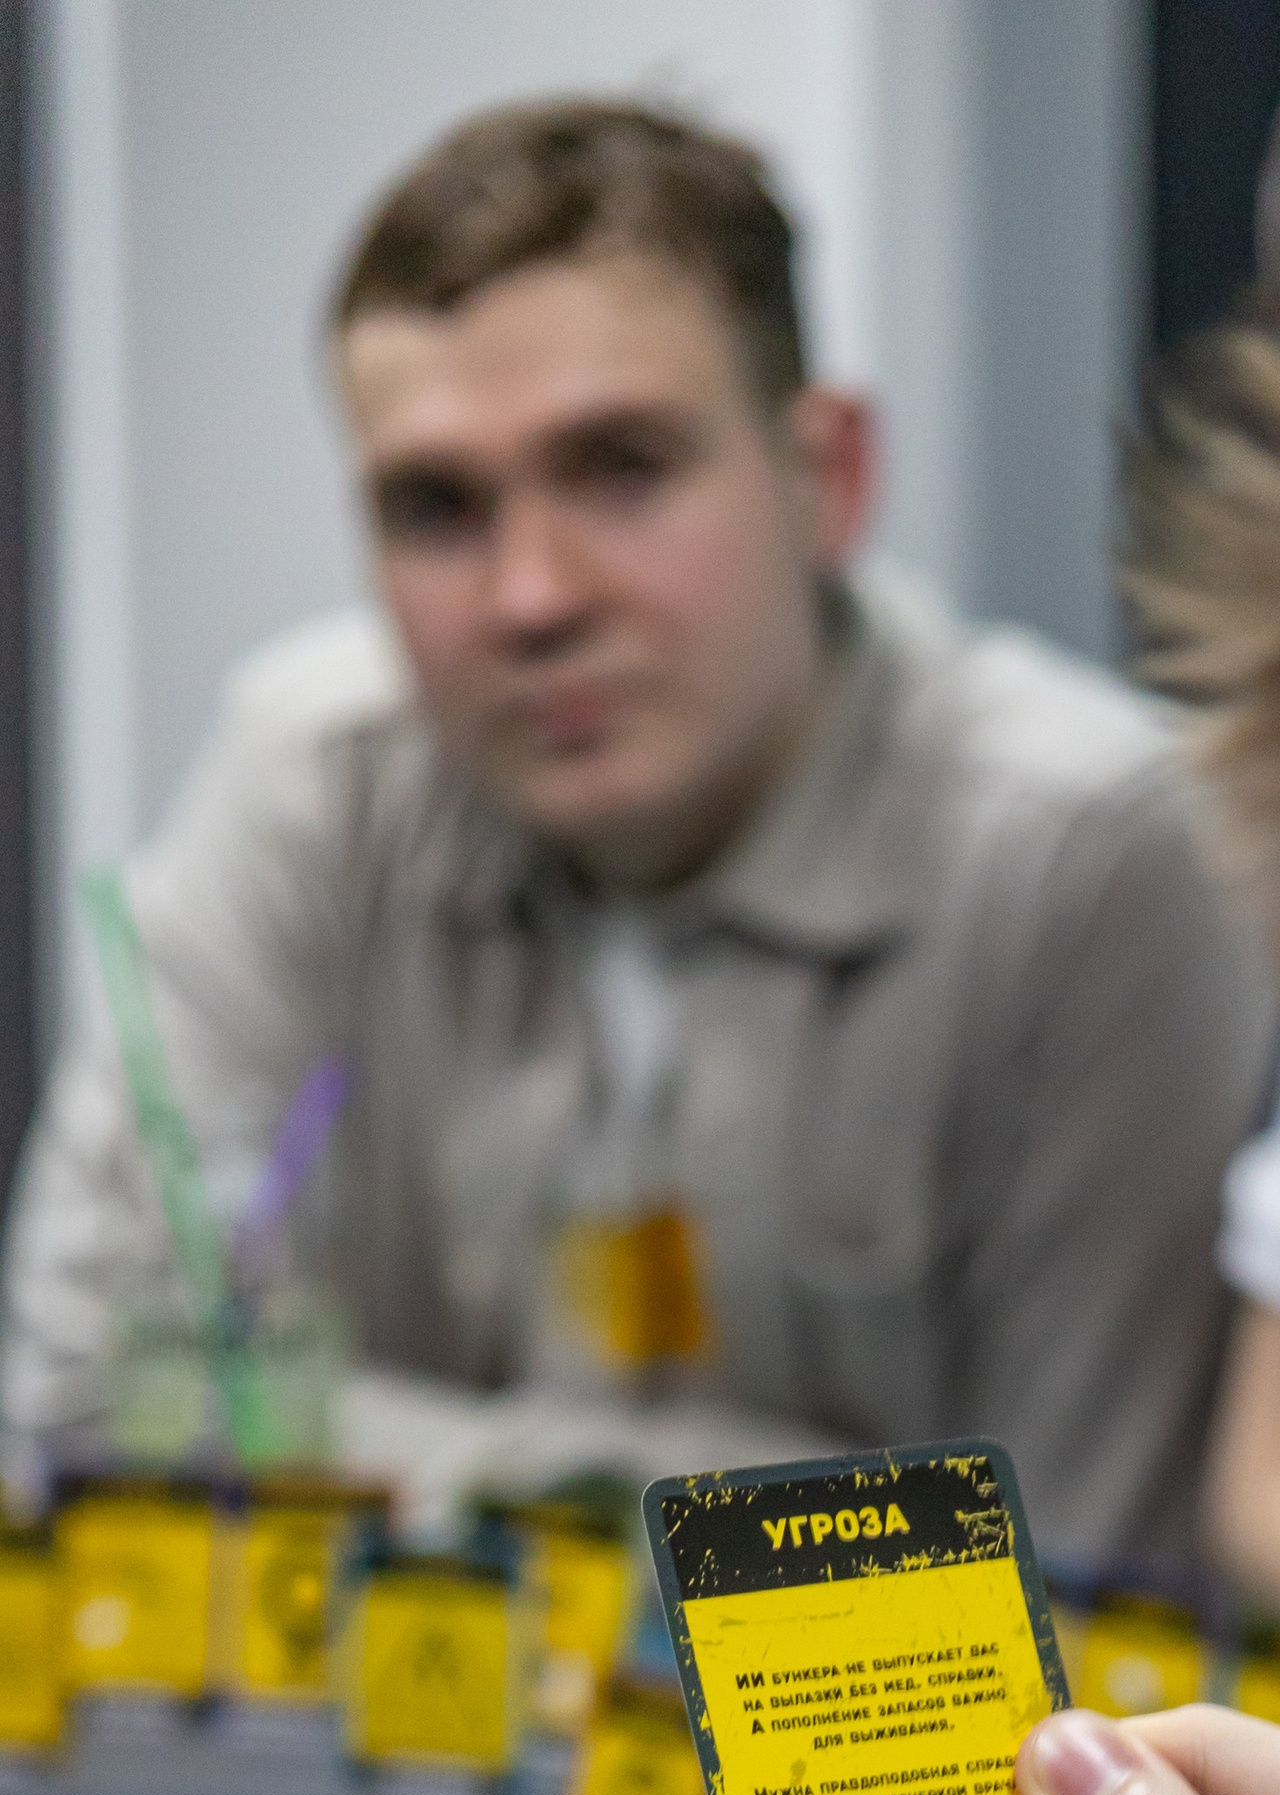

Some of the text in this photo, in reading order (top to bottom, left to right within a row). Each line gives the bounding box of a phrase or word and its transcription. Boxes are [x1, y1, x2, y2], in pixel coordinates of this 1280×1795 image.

[761, 1503, 911, 1550] УГРОЗА
[735, 1642, 999, 1690] ИИ БУНКЕРА НЕ ВЫПУСКАЕТ ВАС
[744, 1699, 764, 1712] НА
[770, 1687, 843, 1709] ВЫЛАЗКИ
[850, 1682, 877, 1697] БЕЗ
[752, 1687, 1006, 1735] А ПОПОЛНЕНИЕ ЗАПАСОВ ВАЖНО
[814, 1733, 843, 1750] ДЛЯ
[820, 1763, 960, 1795] ПРАВДОПОДОБНАЯ
